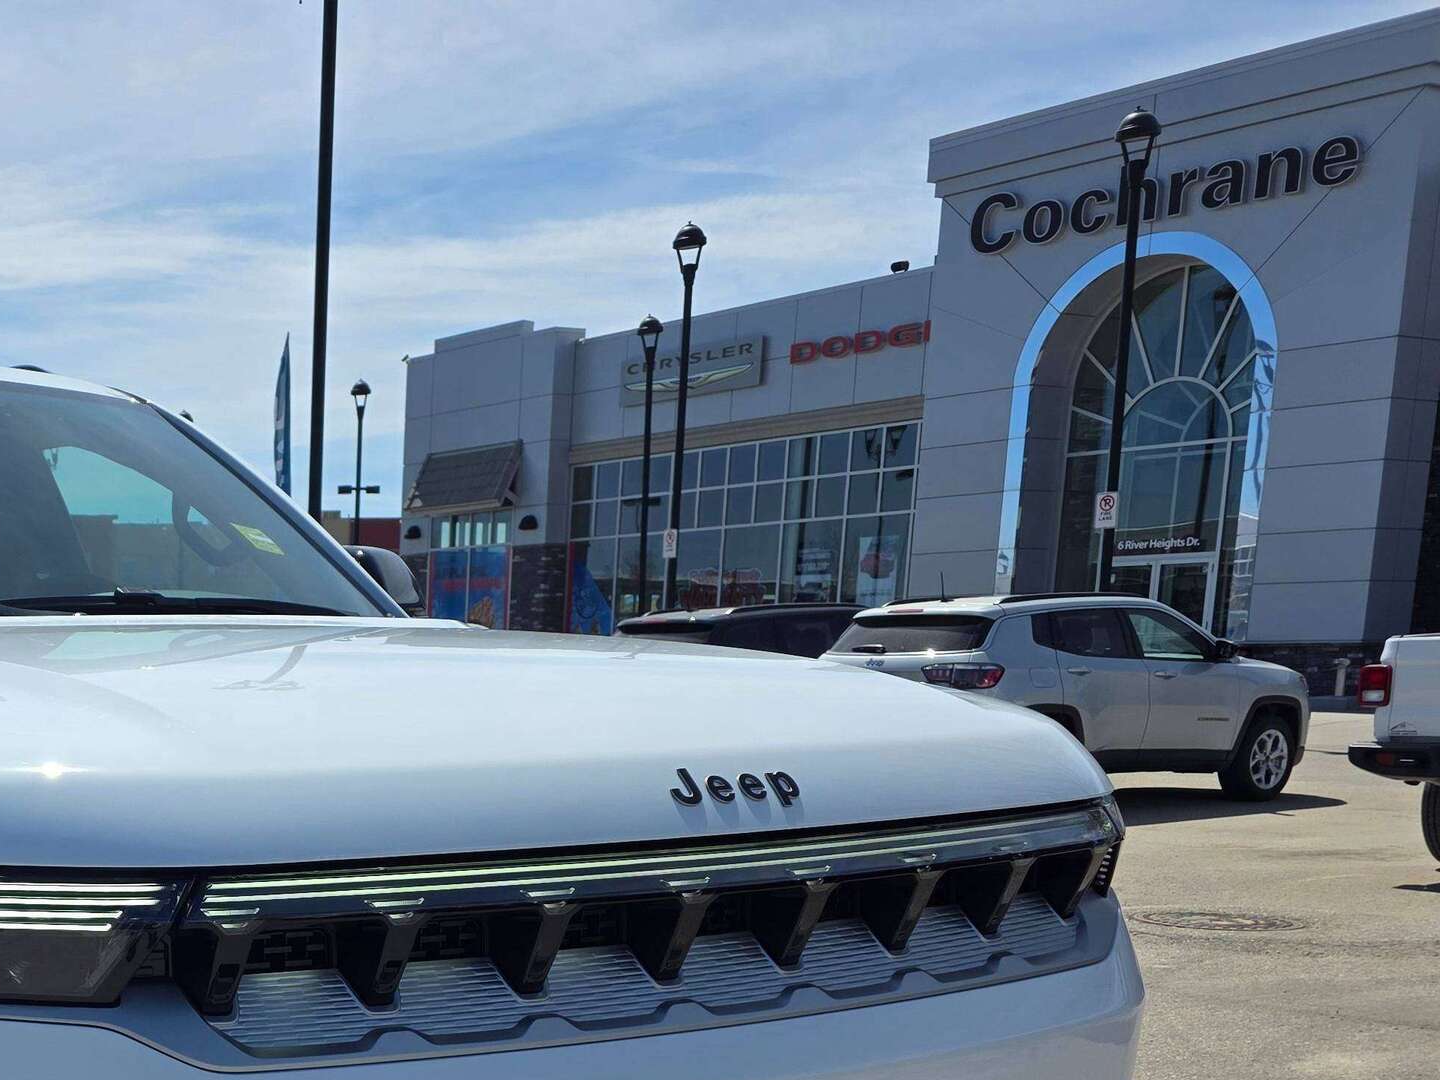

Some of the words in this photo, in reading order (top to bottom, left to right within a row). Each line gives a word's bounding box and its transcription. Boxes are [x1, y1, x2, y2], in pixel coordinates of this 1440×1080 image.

[969, 135, 1360, 255] Cochrane
[790, 320, 932, 364] DODG
[1117, 540, 1125, 550] 6
[1124, 539, 1149, 550] River
[1149, 537, 1186, 550] Heights
[1186, 536, 1200, 547] Dr.
[670, 767, 801, 807] Jeep
